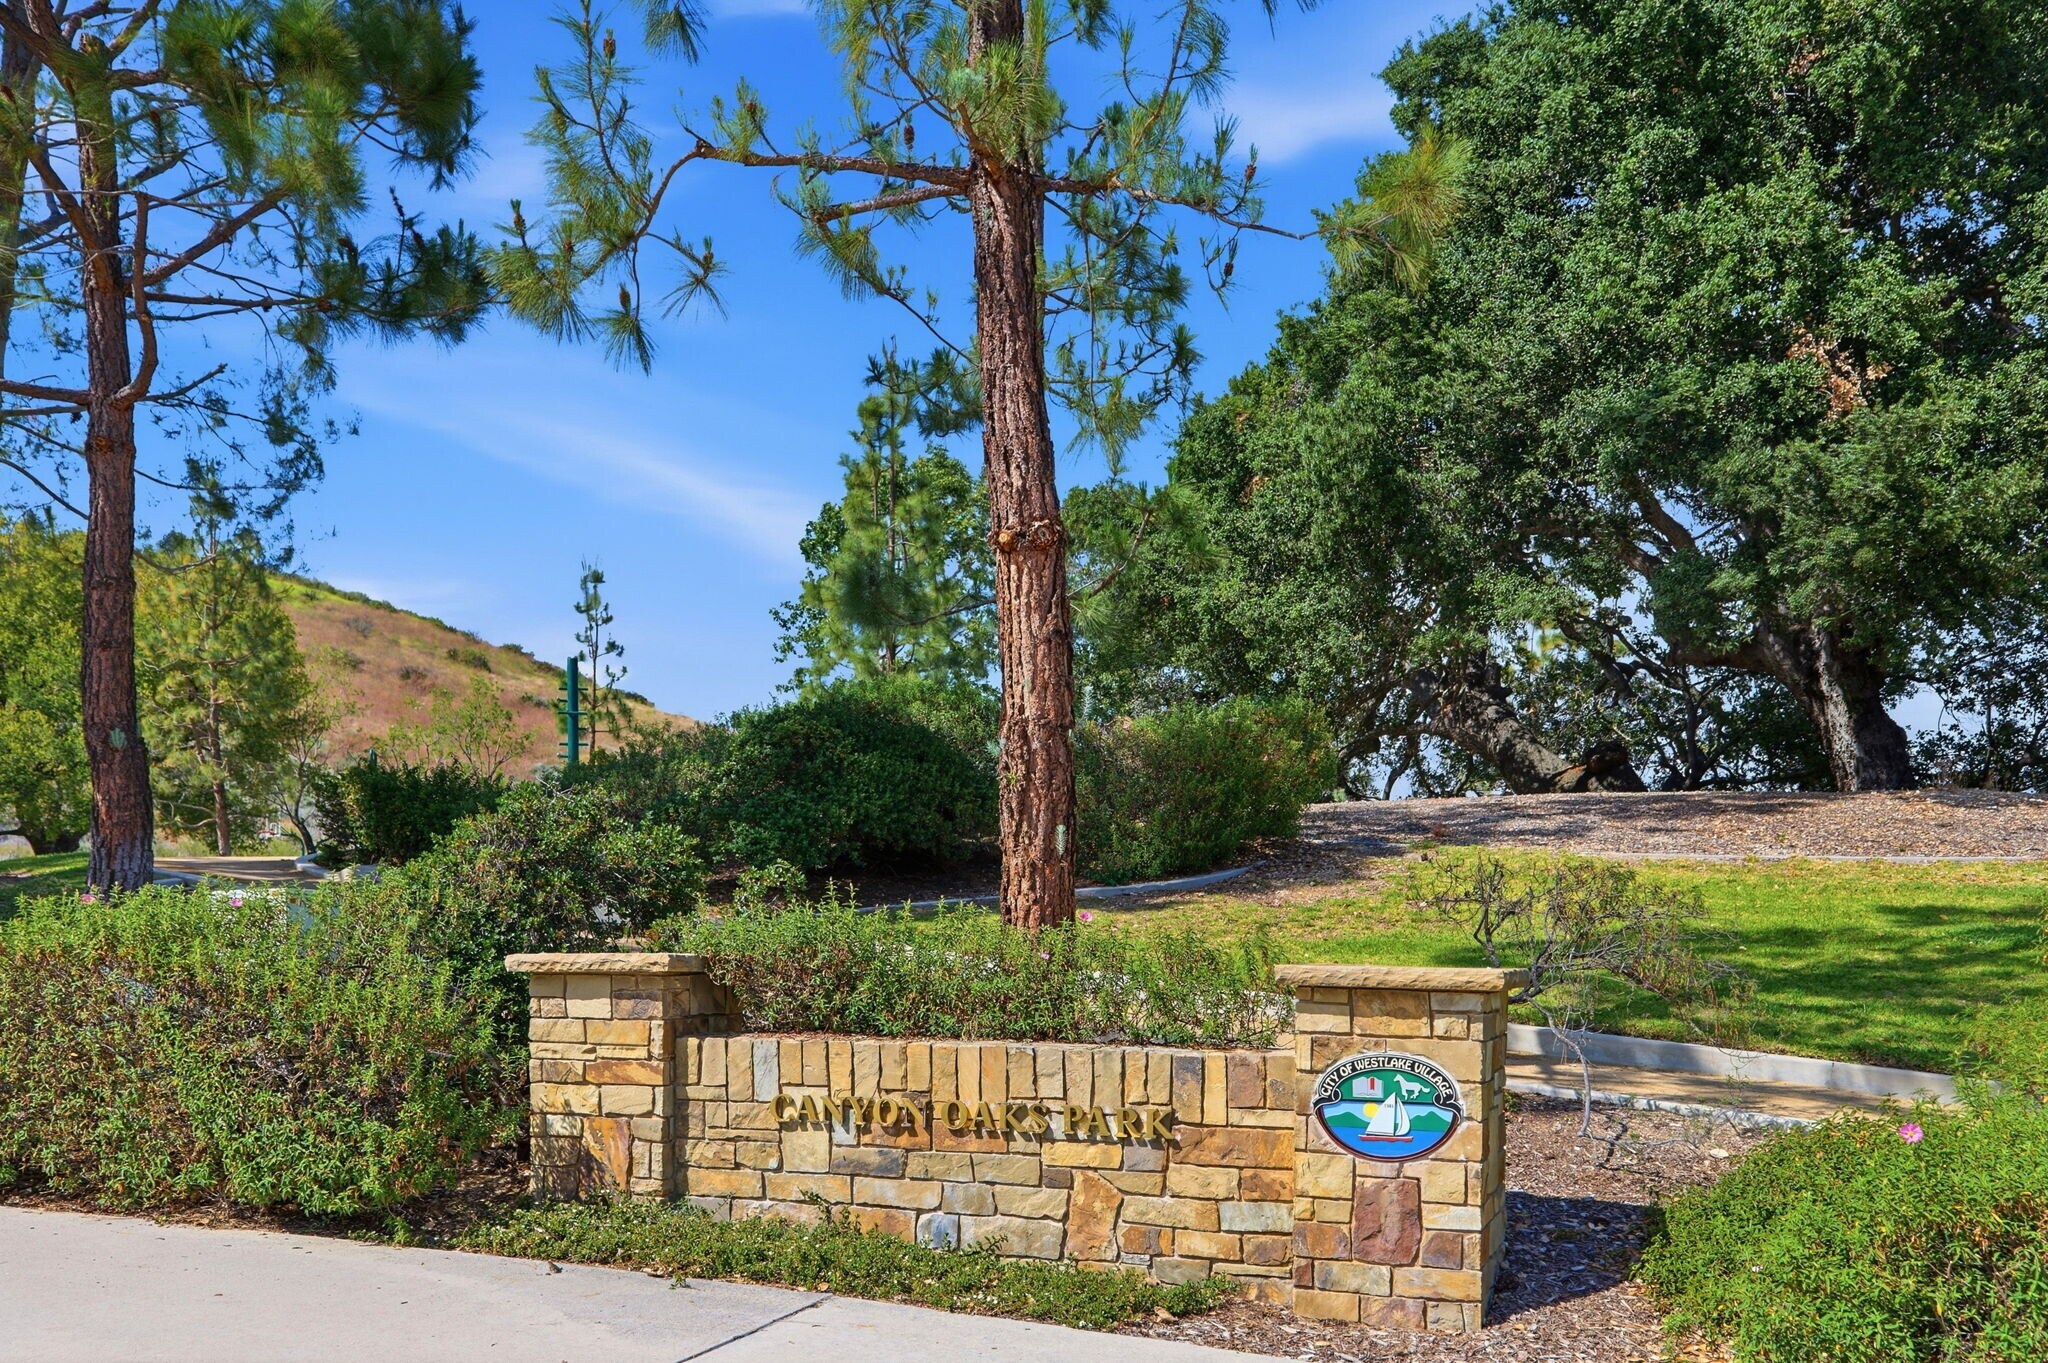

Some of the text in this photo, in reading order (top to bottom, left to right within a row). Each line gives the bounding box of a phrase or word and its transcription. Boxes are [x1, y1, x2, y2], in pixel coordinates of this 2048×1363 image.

[1321, 1057, 1453, 1096] CITY OF WESTLAKE VILLAGE
[769, 1093, 1178, 1141] CANYON OAKS PARK
